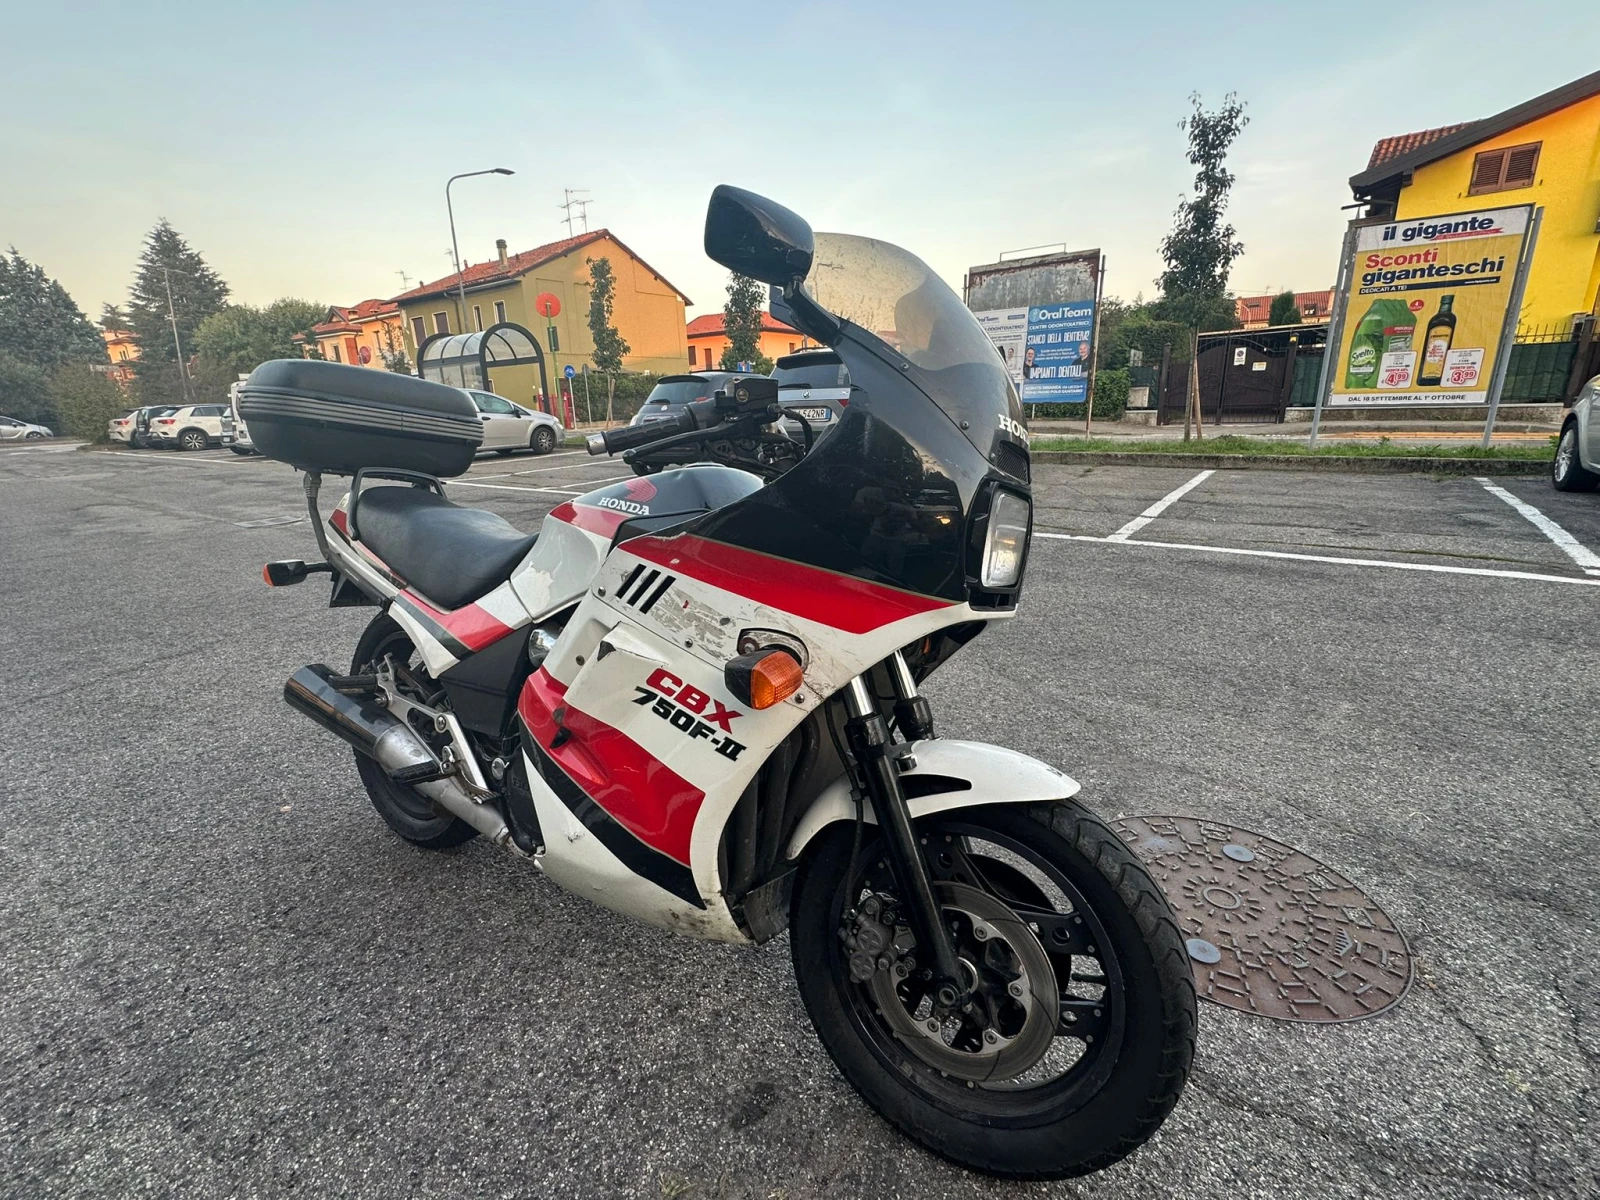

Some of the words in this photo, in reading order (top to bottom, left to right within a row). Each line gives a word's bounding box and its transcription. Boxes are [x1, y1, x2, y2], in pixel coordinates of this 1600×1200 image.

[1383, 225, 1397, 241] il
[1402, 217, 1494, 241] gigante
[1365, 248, 1439, 269] Sconti
[1362, 256, 1505, 286] giganteschi
[1360, 286, 1390, 294] DEDICATI
[1029, 323, 1048, 331] CENTRI
[1048, 321, 1089, 329] ODONTOIATRICI
[1027, 334, 1046, 345] STANCO
[1047, 332, 1062, 344] DELLA
[1351, 348, 1374, 362] Svelto
[1030, 366, 1056, 379] IMPIANTI
[1058, 364, 1082, 378] DENTALI
[597, 497, 650, 516] HONDA
[646, 668, 744, 734] CBX
[631, 686, 747, 762] 750F-II
